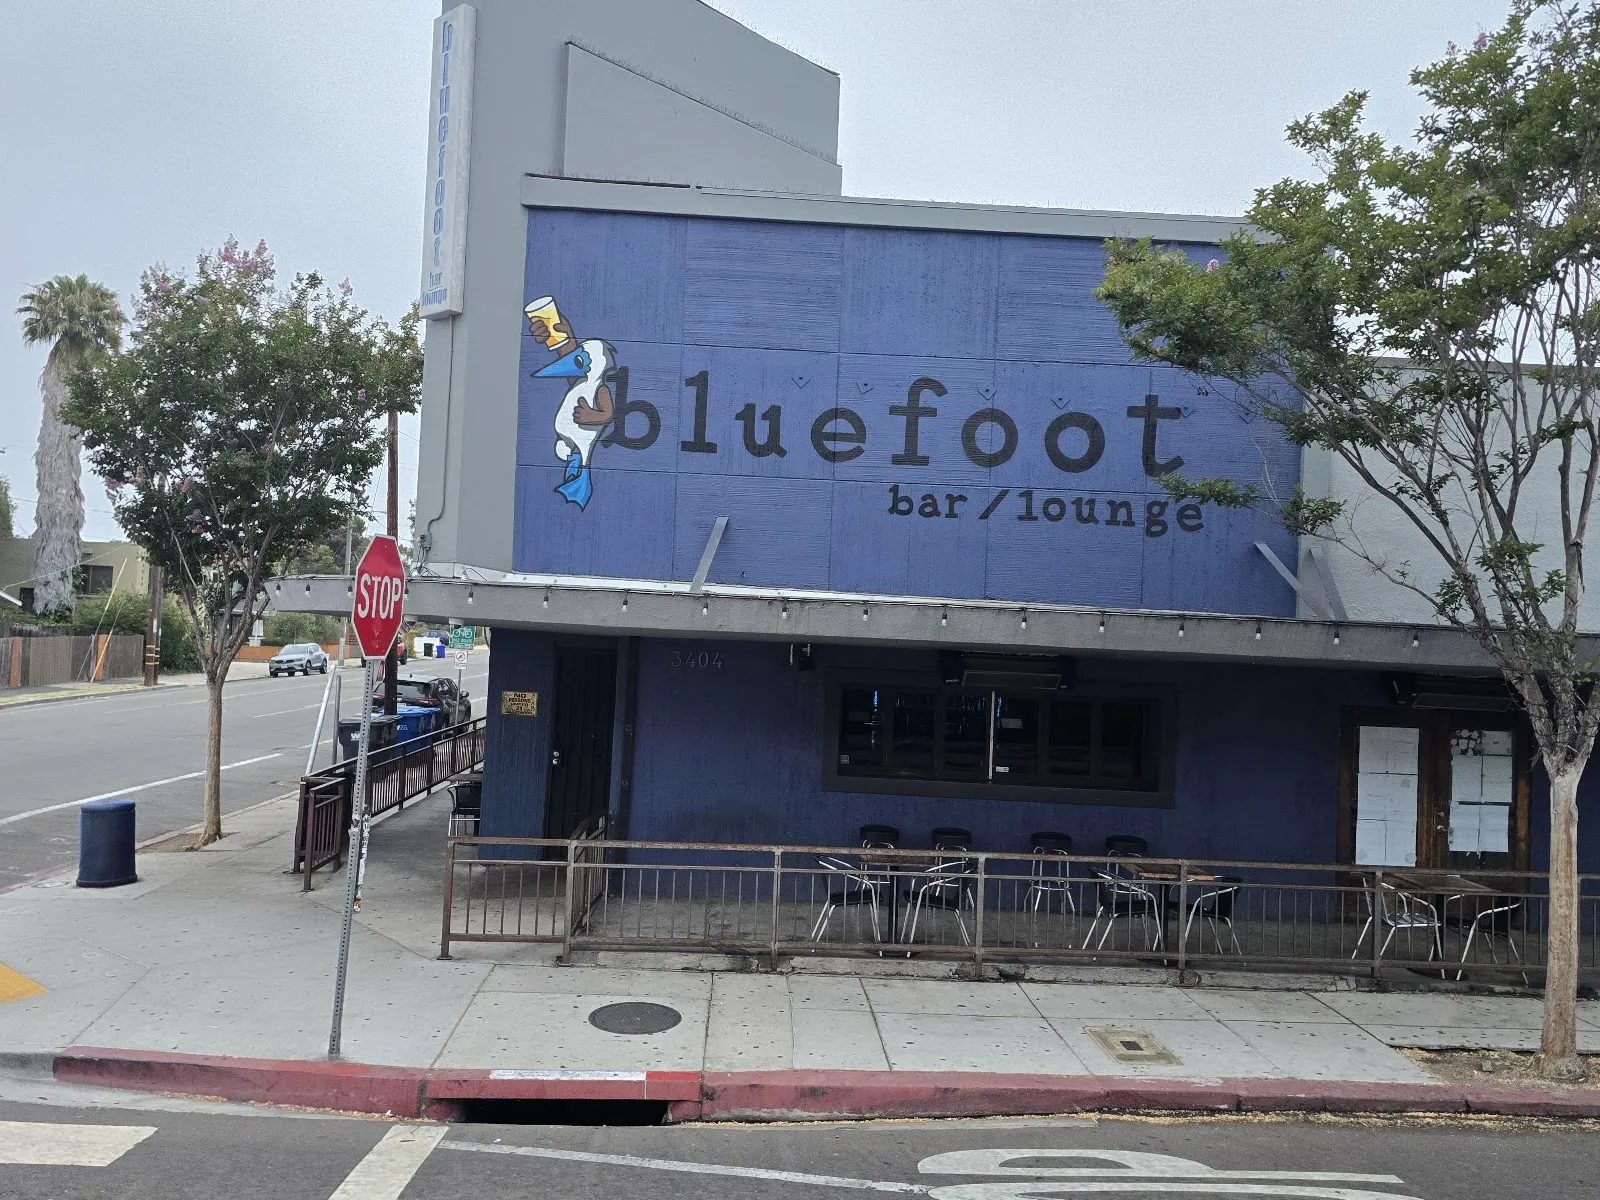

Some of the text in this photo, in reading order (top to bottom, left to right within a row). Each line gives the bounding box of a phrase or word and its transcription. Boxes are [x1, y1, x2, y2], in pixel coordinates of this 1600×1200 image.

[433, 21, 453, 267] bluefoot
[601, 366, 1185, 477] bluefoot
[357, 573, 401, 620] STOP
[672, 650, 722, 668] 3404
